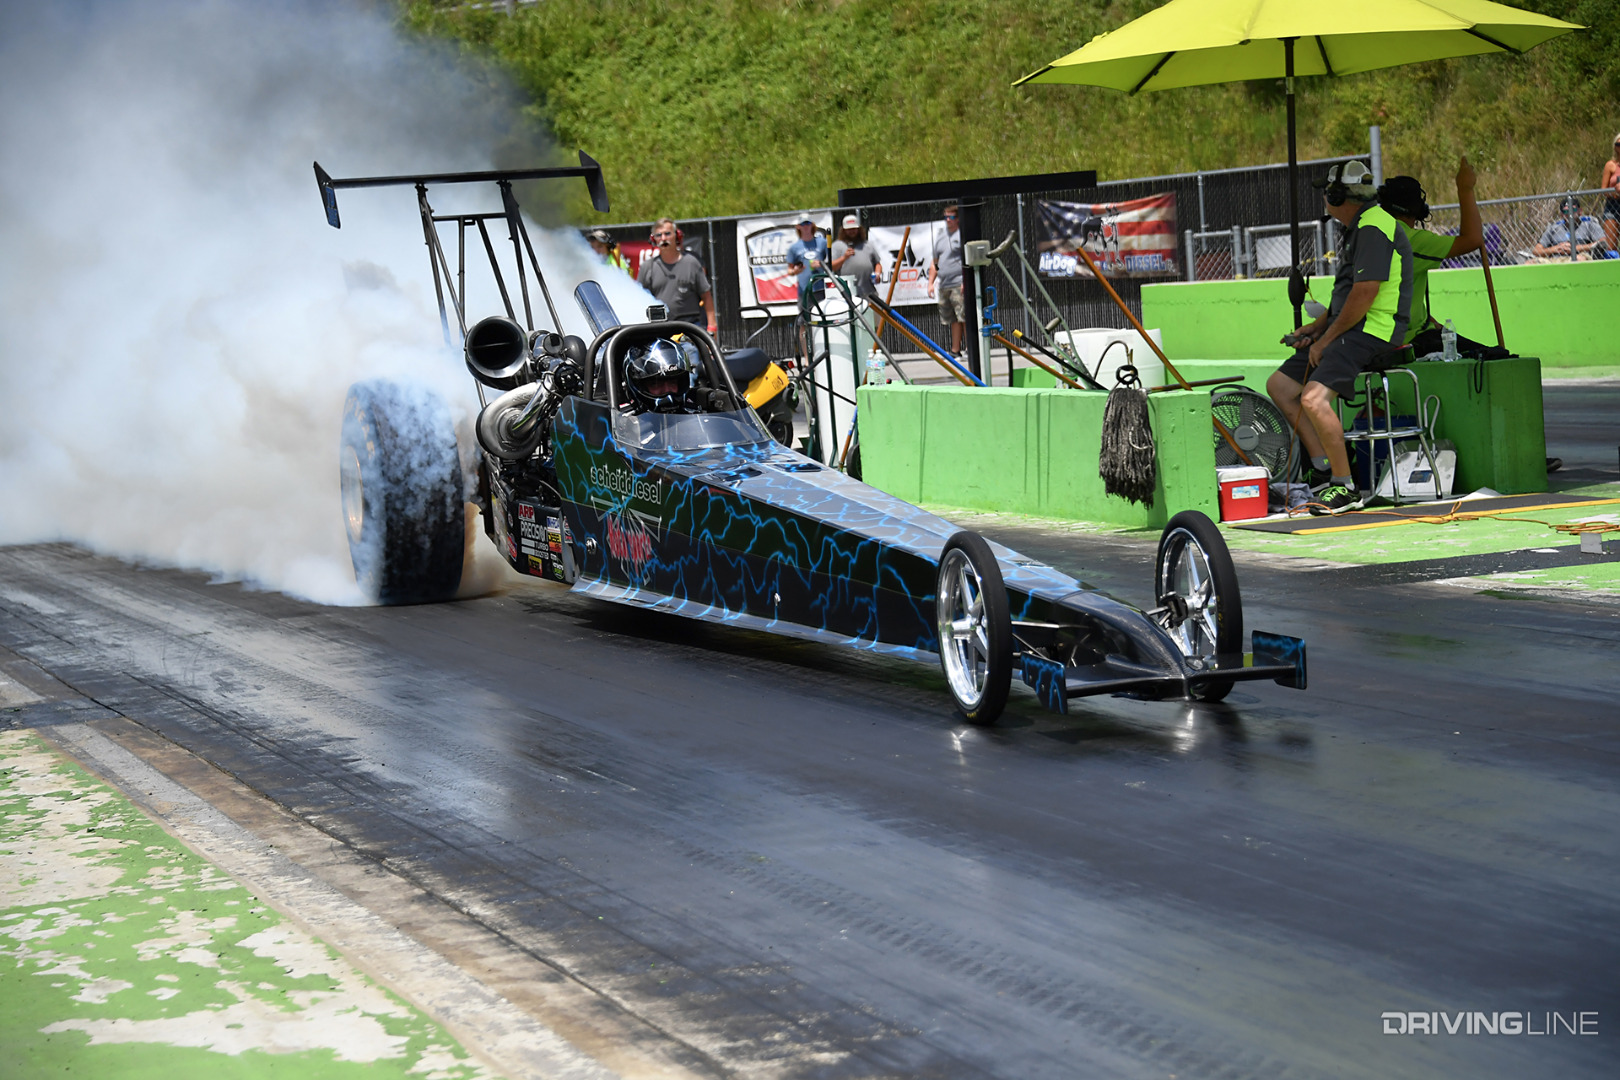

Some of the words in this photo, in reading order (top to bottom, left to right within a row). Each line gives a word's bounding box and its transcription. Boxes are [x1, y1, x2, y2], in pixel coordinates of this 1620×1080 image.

[752, 256, 787, 264] MOTOR
[1039, 252, 1077, 275] AirDog
[1125, 253, 1167, 272] DIESEL
[590, 463, 662, 505] scheiddiesel
[519, 504, 535, 519] ARP
[520, 520, 549, 543] PRECISION
[534, 542, 549, 552] TURBO
